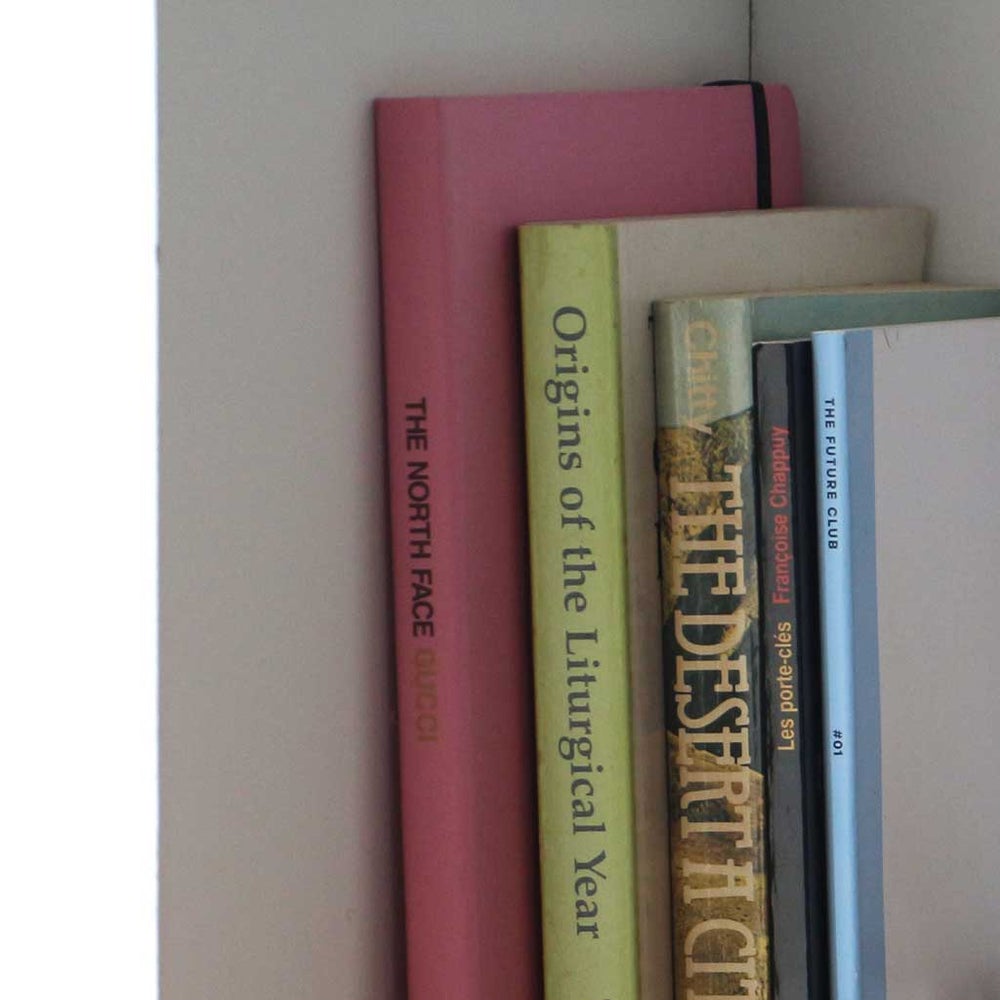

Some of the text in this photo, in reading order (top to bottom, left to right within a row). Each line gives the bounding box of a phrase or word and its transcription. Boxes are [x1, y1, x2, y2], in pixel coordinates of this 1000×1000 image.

[544, 306, 591, 471] Origins
[559, 487, 596, 531] of
[669, 464, 747, 596] THE
[769, 425, 793, 605] Françoise Chappuy
[824, 397, 839, 550] THE FUTURE CLUB
[405, 397, 440, 743] THE NORTH FACE GUCCI
[562, 545, 597, 613] the
[558, 629, 607, 836] Liturgical
[673, 609, 754, 849] DESERT
[773, 621, 798, 751] Les porte-clés
[832, 729, 844, 756] #01
[573, 850, 608, 939] Year
[682, 858, 755, 905] A
